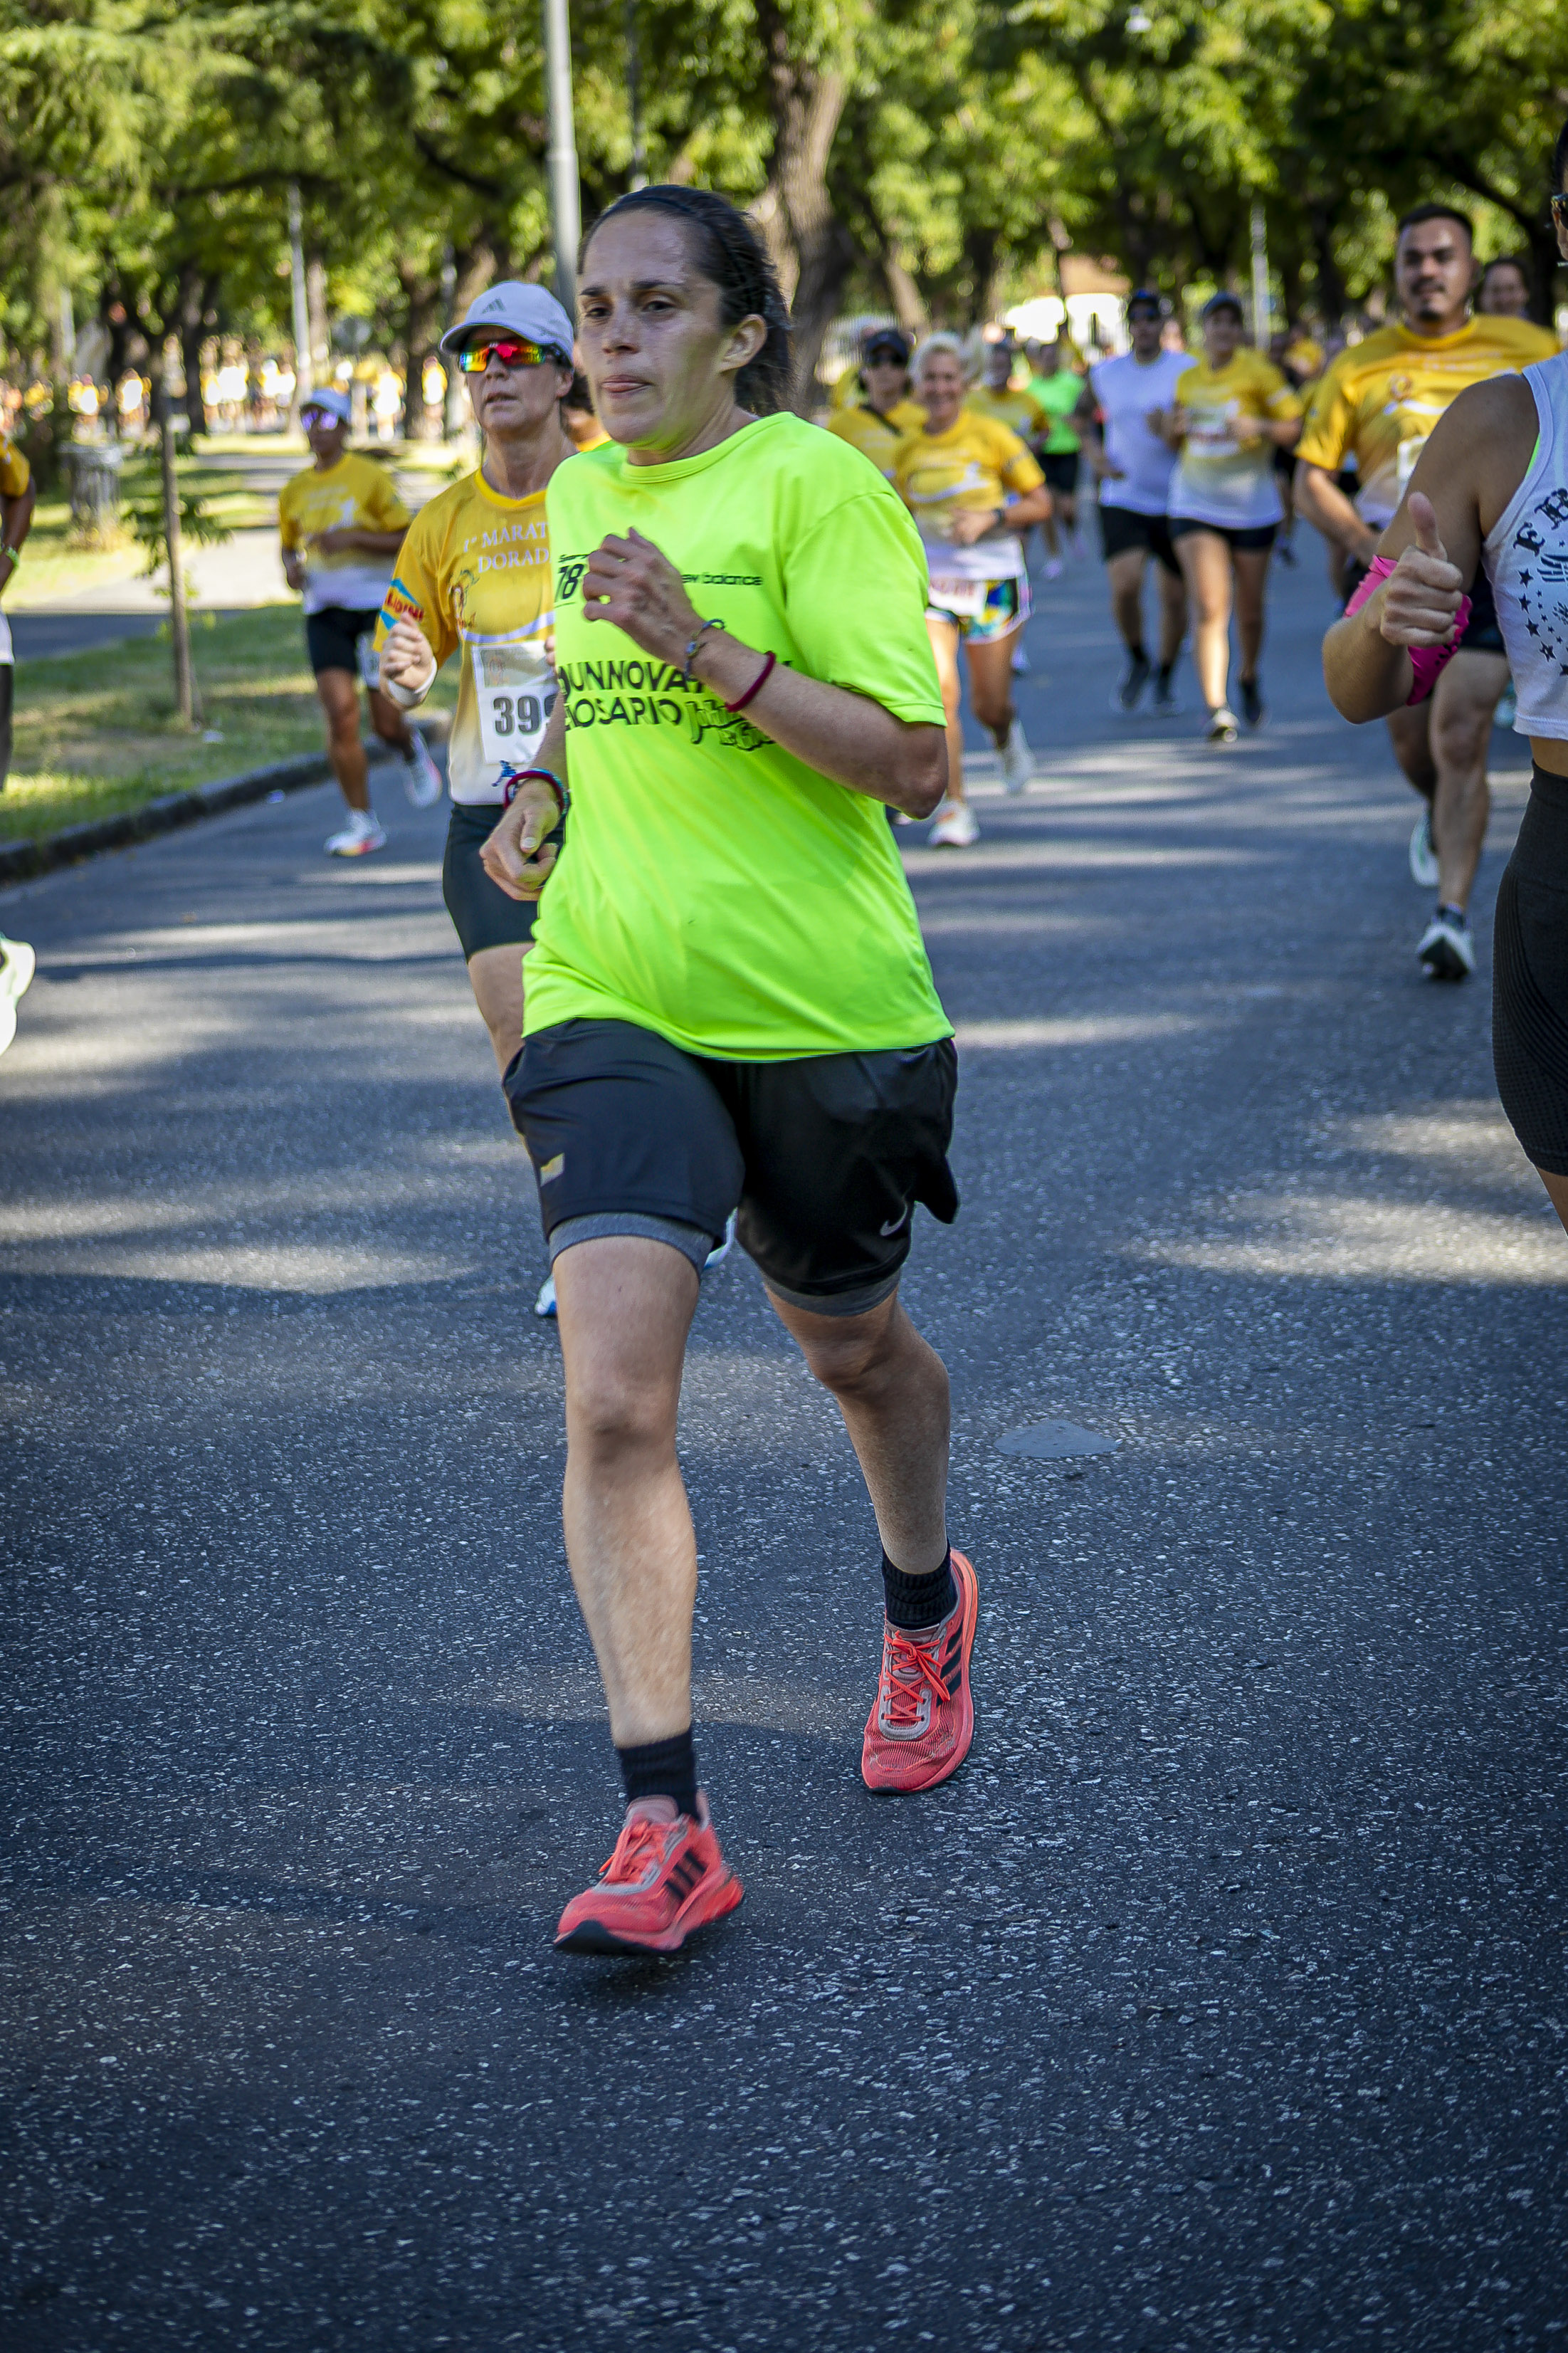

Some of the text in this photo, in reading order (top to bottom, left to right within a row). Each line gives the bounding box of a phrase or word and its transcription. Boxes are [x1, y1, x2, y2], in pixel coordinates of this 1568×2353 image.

[481, 521, 549, 549] MARAT
[478, 547, 551, 574] DORAD
[680, 572, 764, 586] ew balance
